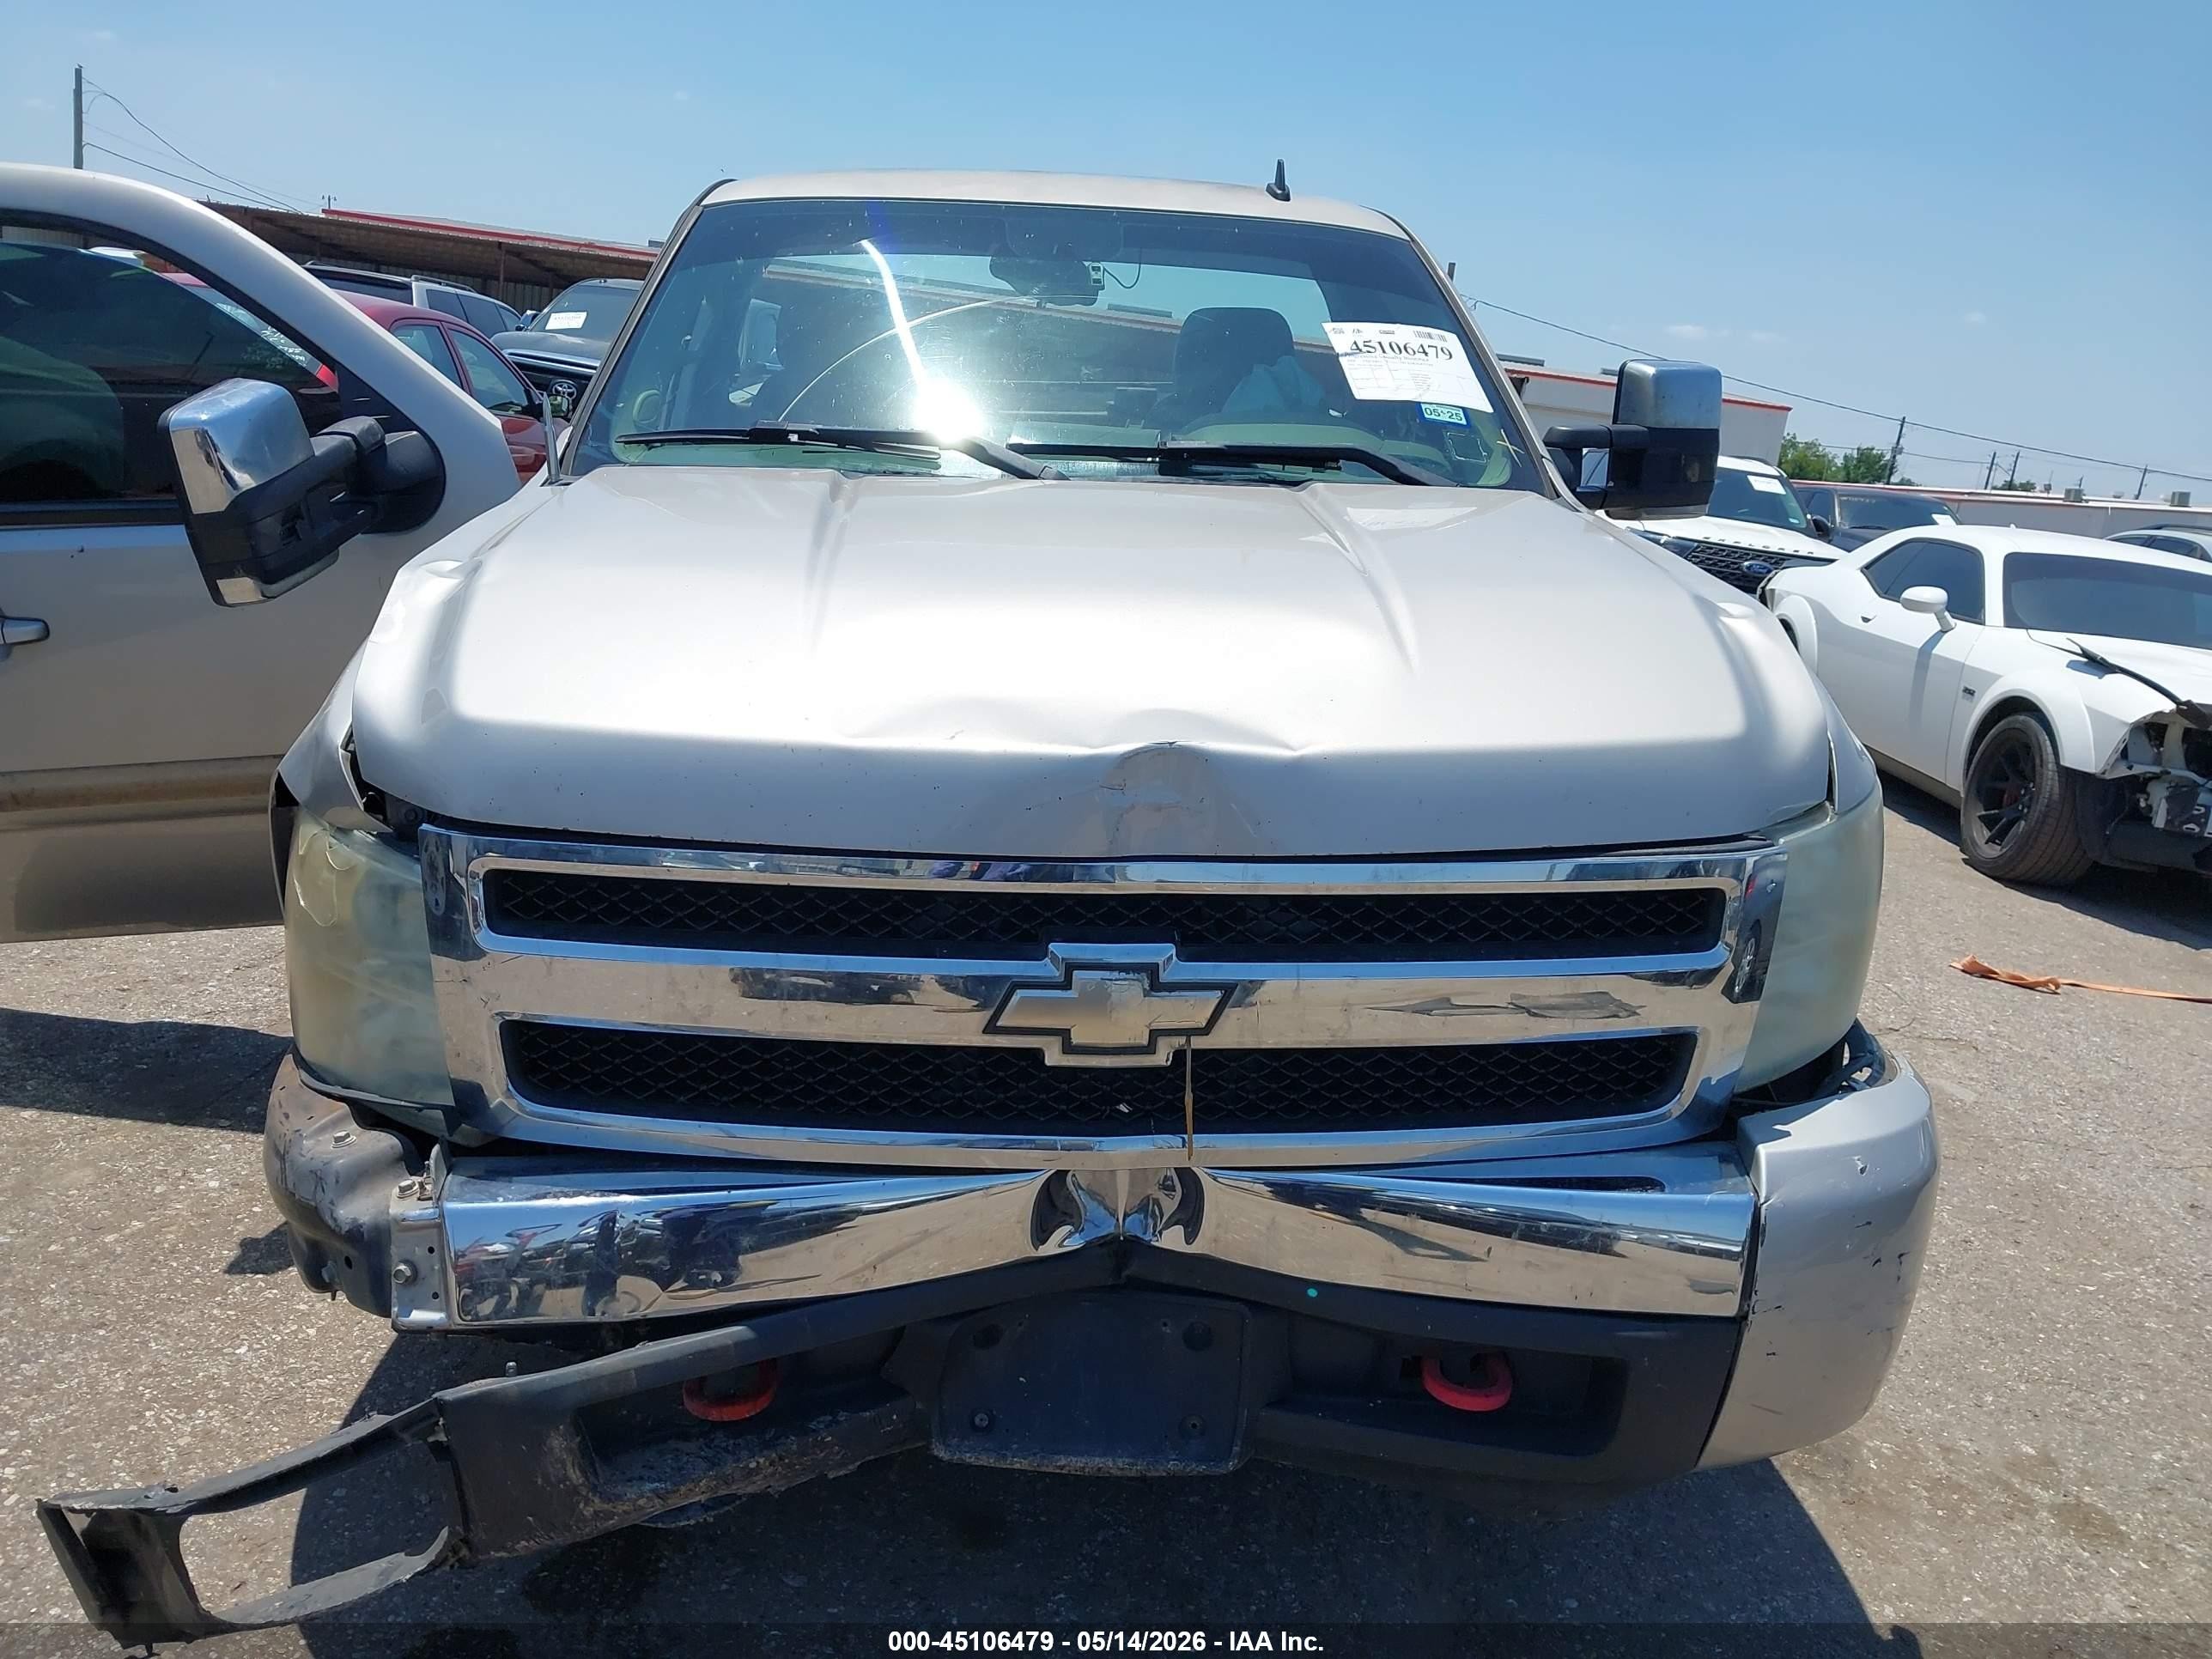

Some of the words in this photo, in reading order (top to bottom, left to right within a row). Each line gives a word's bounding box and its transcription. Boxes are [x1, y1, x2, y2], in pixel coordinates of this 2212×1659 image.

[1350, 339, 1453, 361] 45106479
[1424, 407, 1441, 417] 05
[1447, 410, 1463, 422] 25
